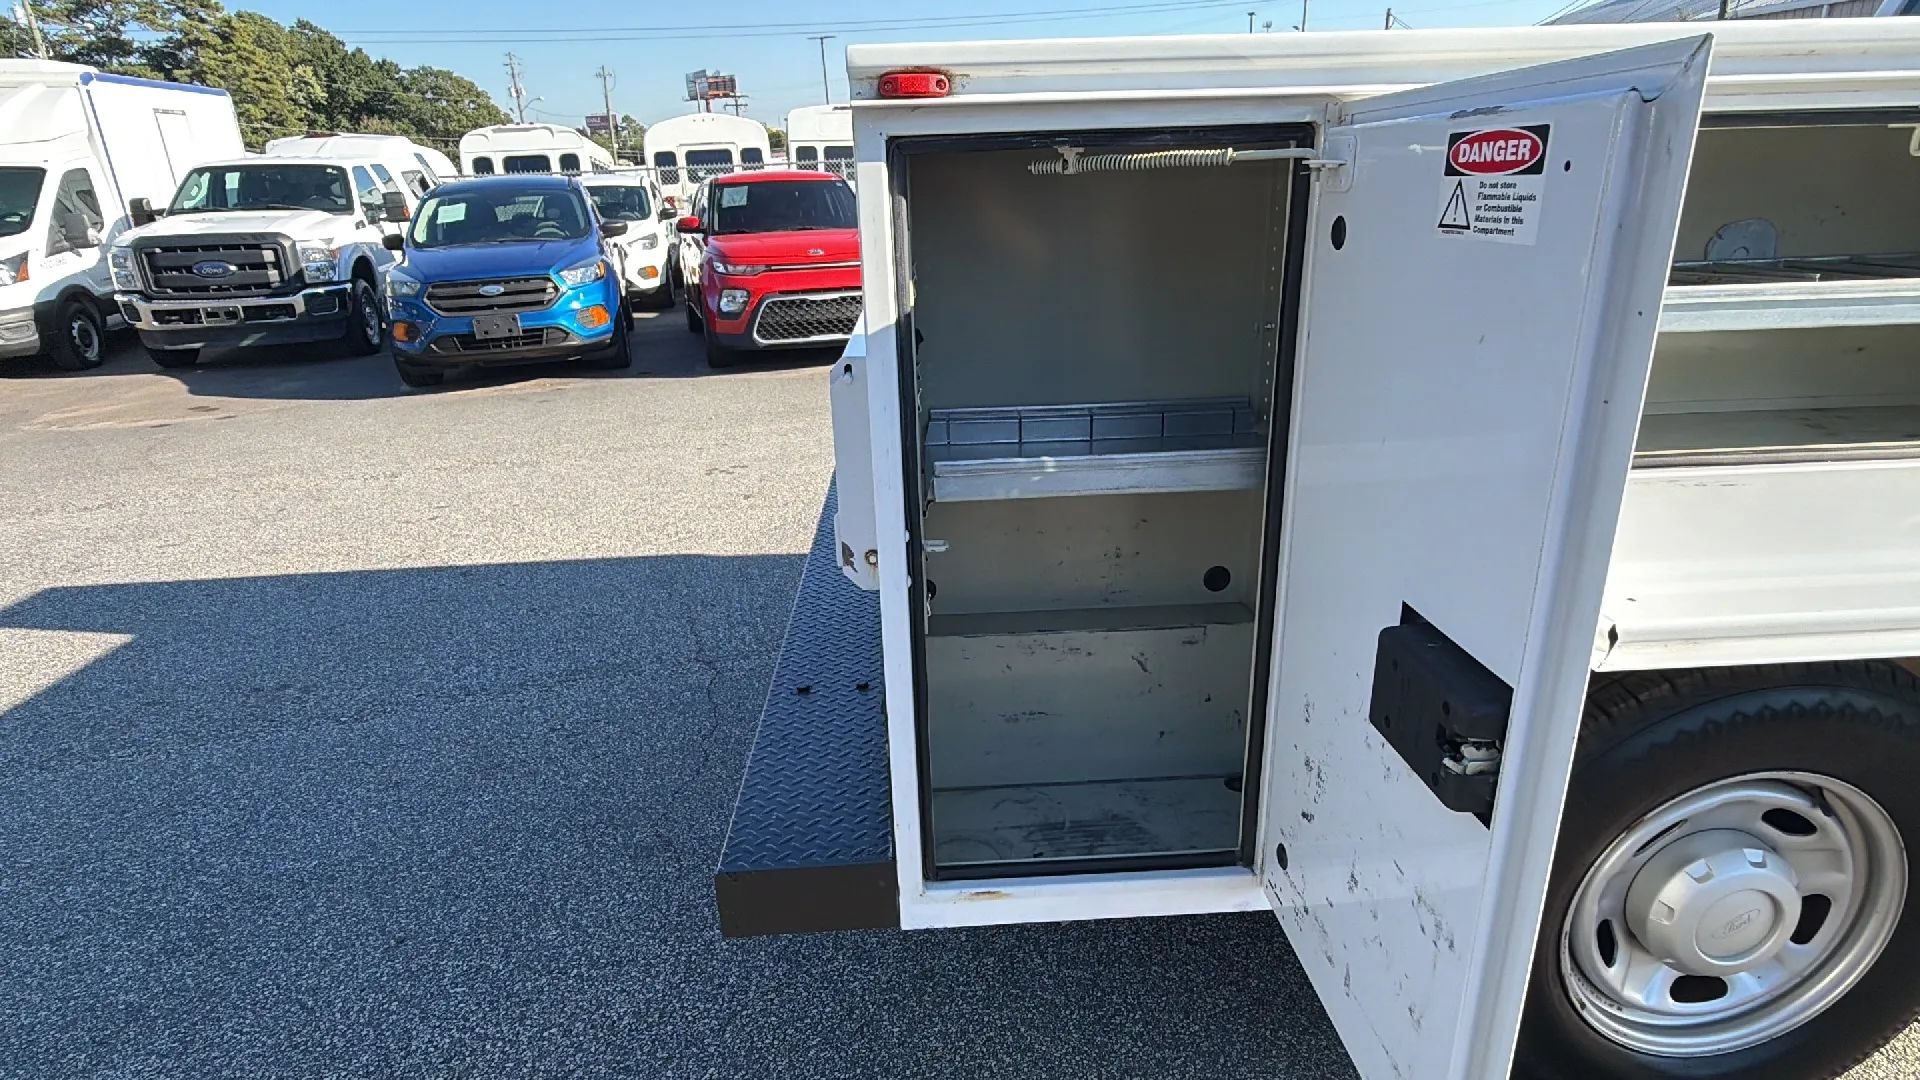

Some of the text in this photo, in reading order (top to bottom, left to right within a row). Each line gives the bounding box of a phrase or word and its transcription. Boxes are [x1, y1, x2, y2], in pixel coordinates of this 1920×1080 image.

[1458, 139, 1532, 163] DANGER
[1479, 181, 1487, 189] Do
[1488, 181, 1499, 189] not
[1477, 192, 1537, 203] Flammable Liquids
[1484, 204, 1523, 213] Combustible
[1474, 215, 1524, 225] Materials in this
[1472, 226, 1515, 236] Compartment
